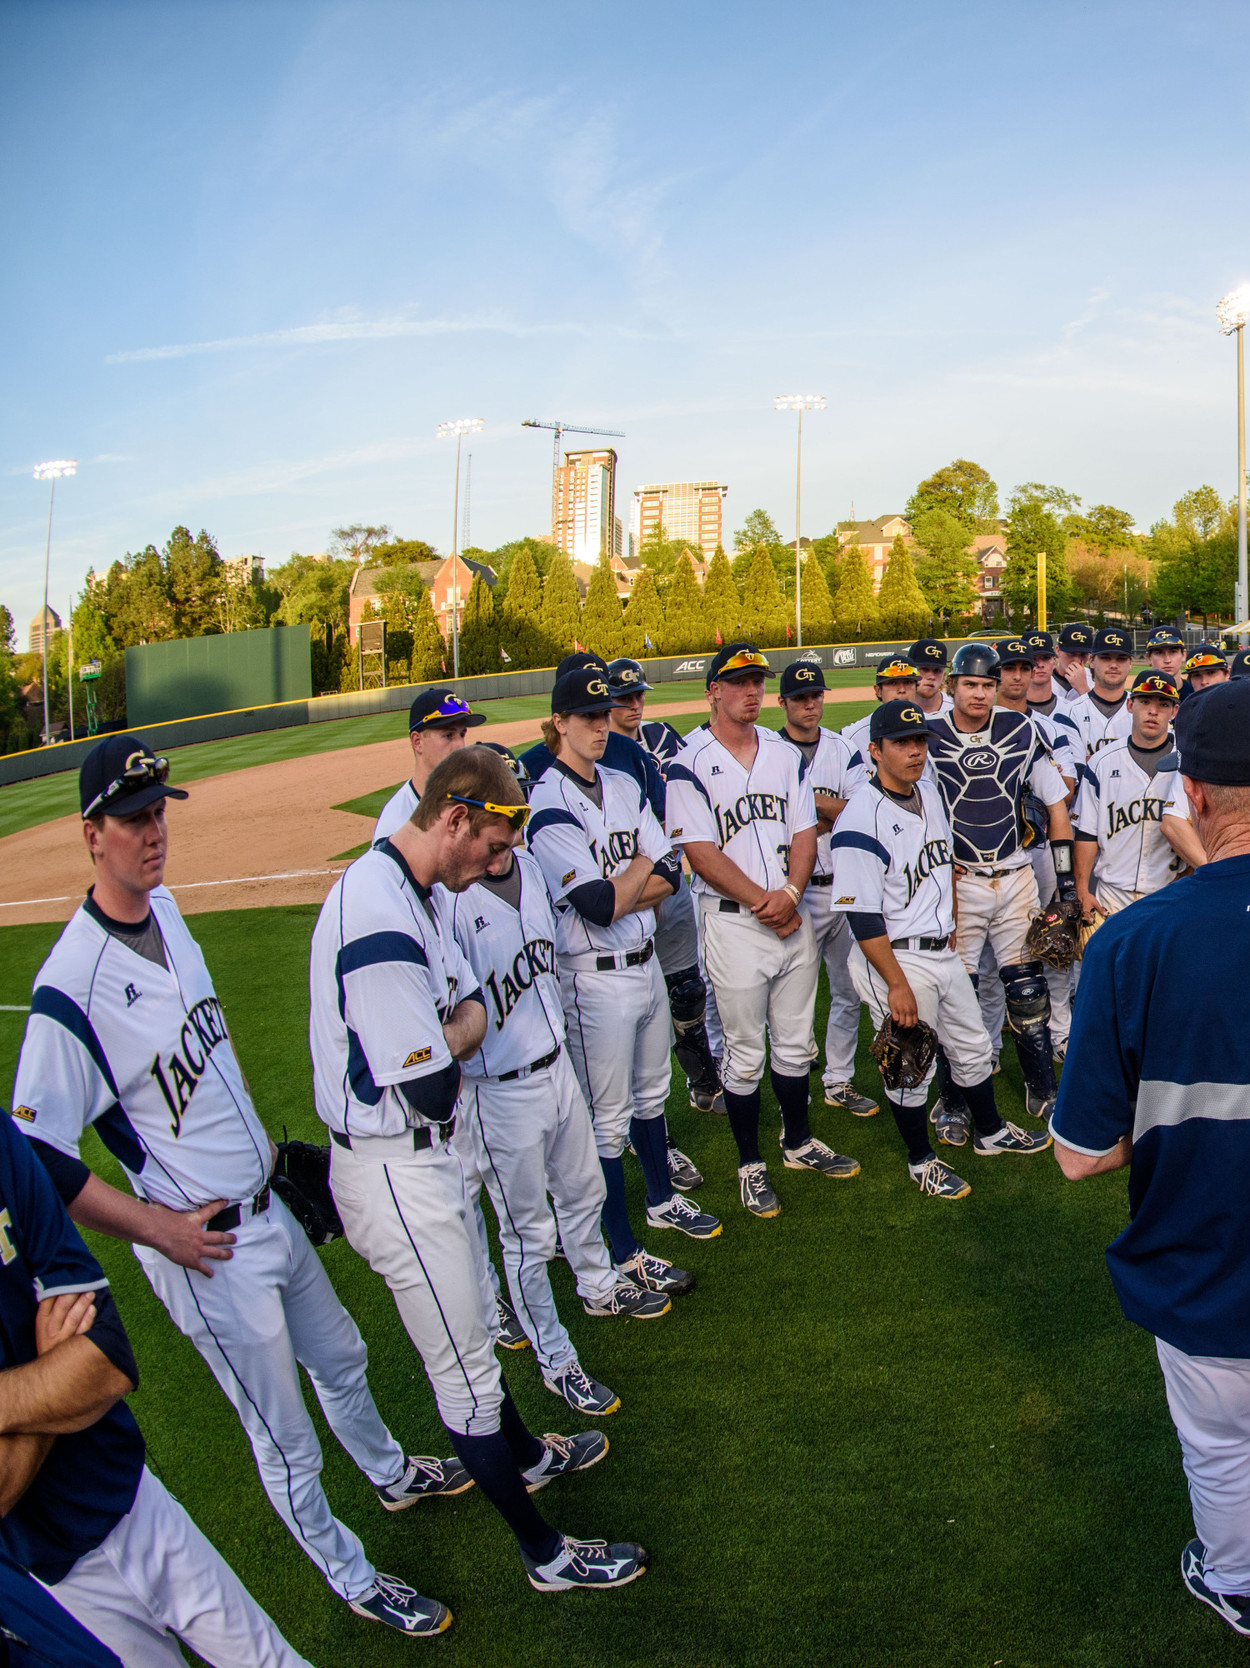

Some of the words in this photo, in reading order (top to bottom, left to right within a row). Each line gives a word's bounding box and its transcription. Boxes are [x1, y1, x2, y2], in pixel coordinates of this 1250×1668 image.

[1028, 636, 1046, 647] GT
[1070, 631, 1087, 643] GT
[1104, 633, 1124, 646] GT
[925, 645, 942, 658] GT
[1007, 642, 1027, 653] GT
[675, 660, 706, 671] ACC
[621, 669, 640, 683] GT
[795, 668, 816, 681] GT
[586, 678, 609, 696] GT
[900, 707, 923, 724] GT
[969, 735, 983, 743] GT
[903, 838, 953, 910] JACKE
[485, 938, 560, 1032] JACKET
[403, 1047, 431, 1067] ACC
[13, 1105, 36, 1121] ACC
